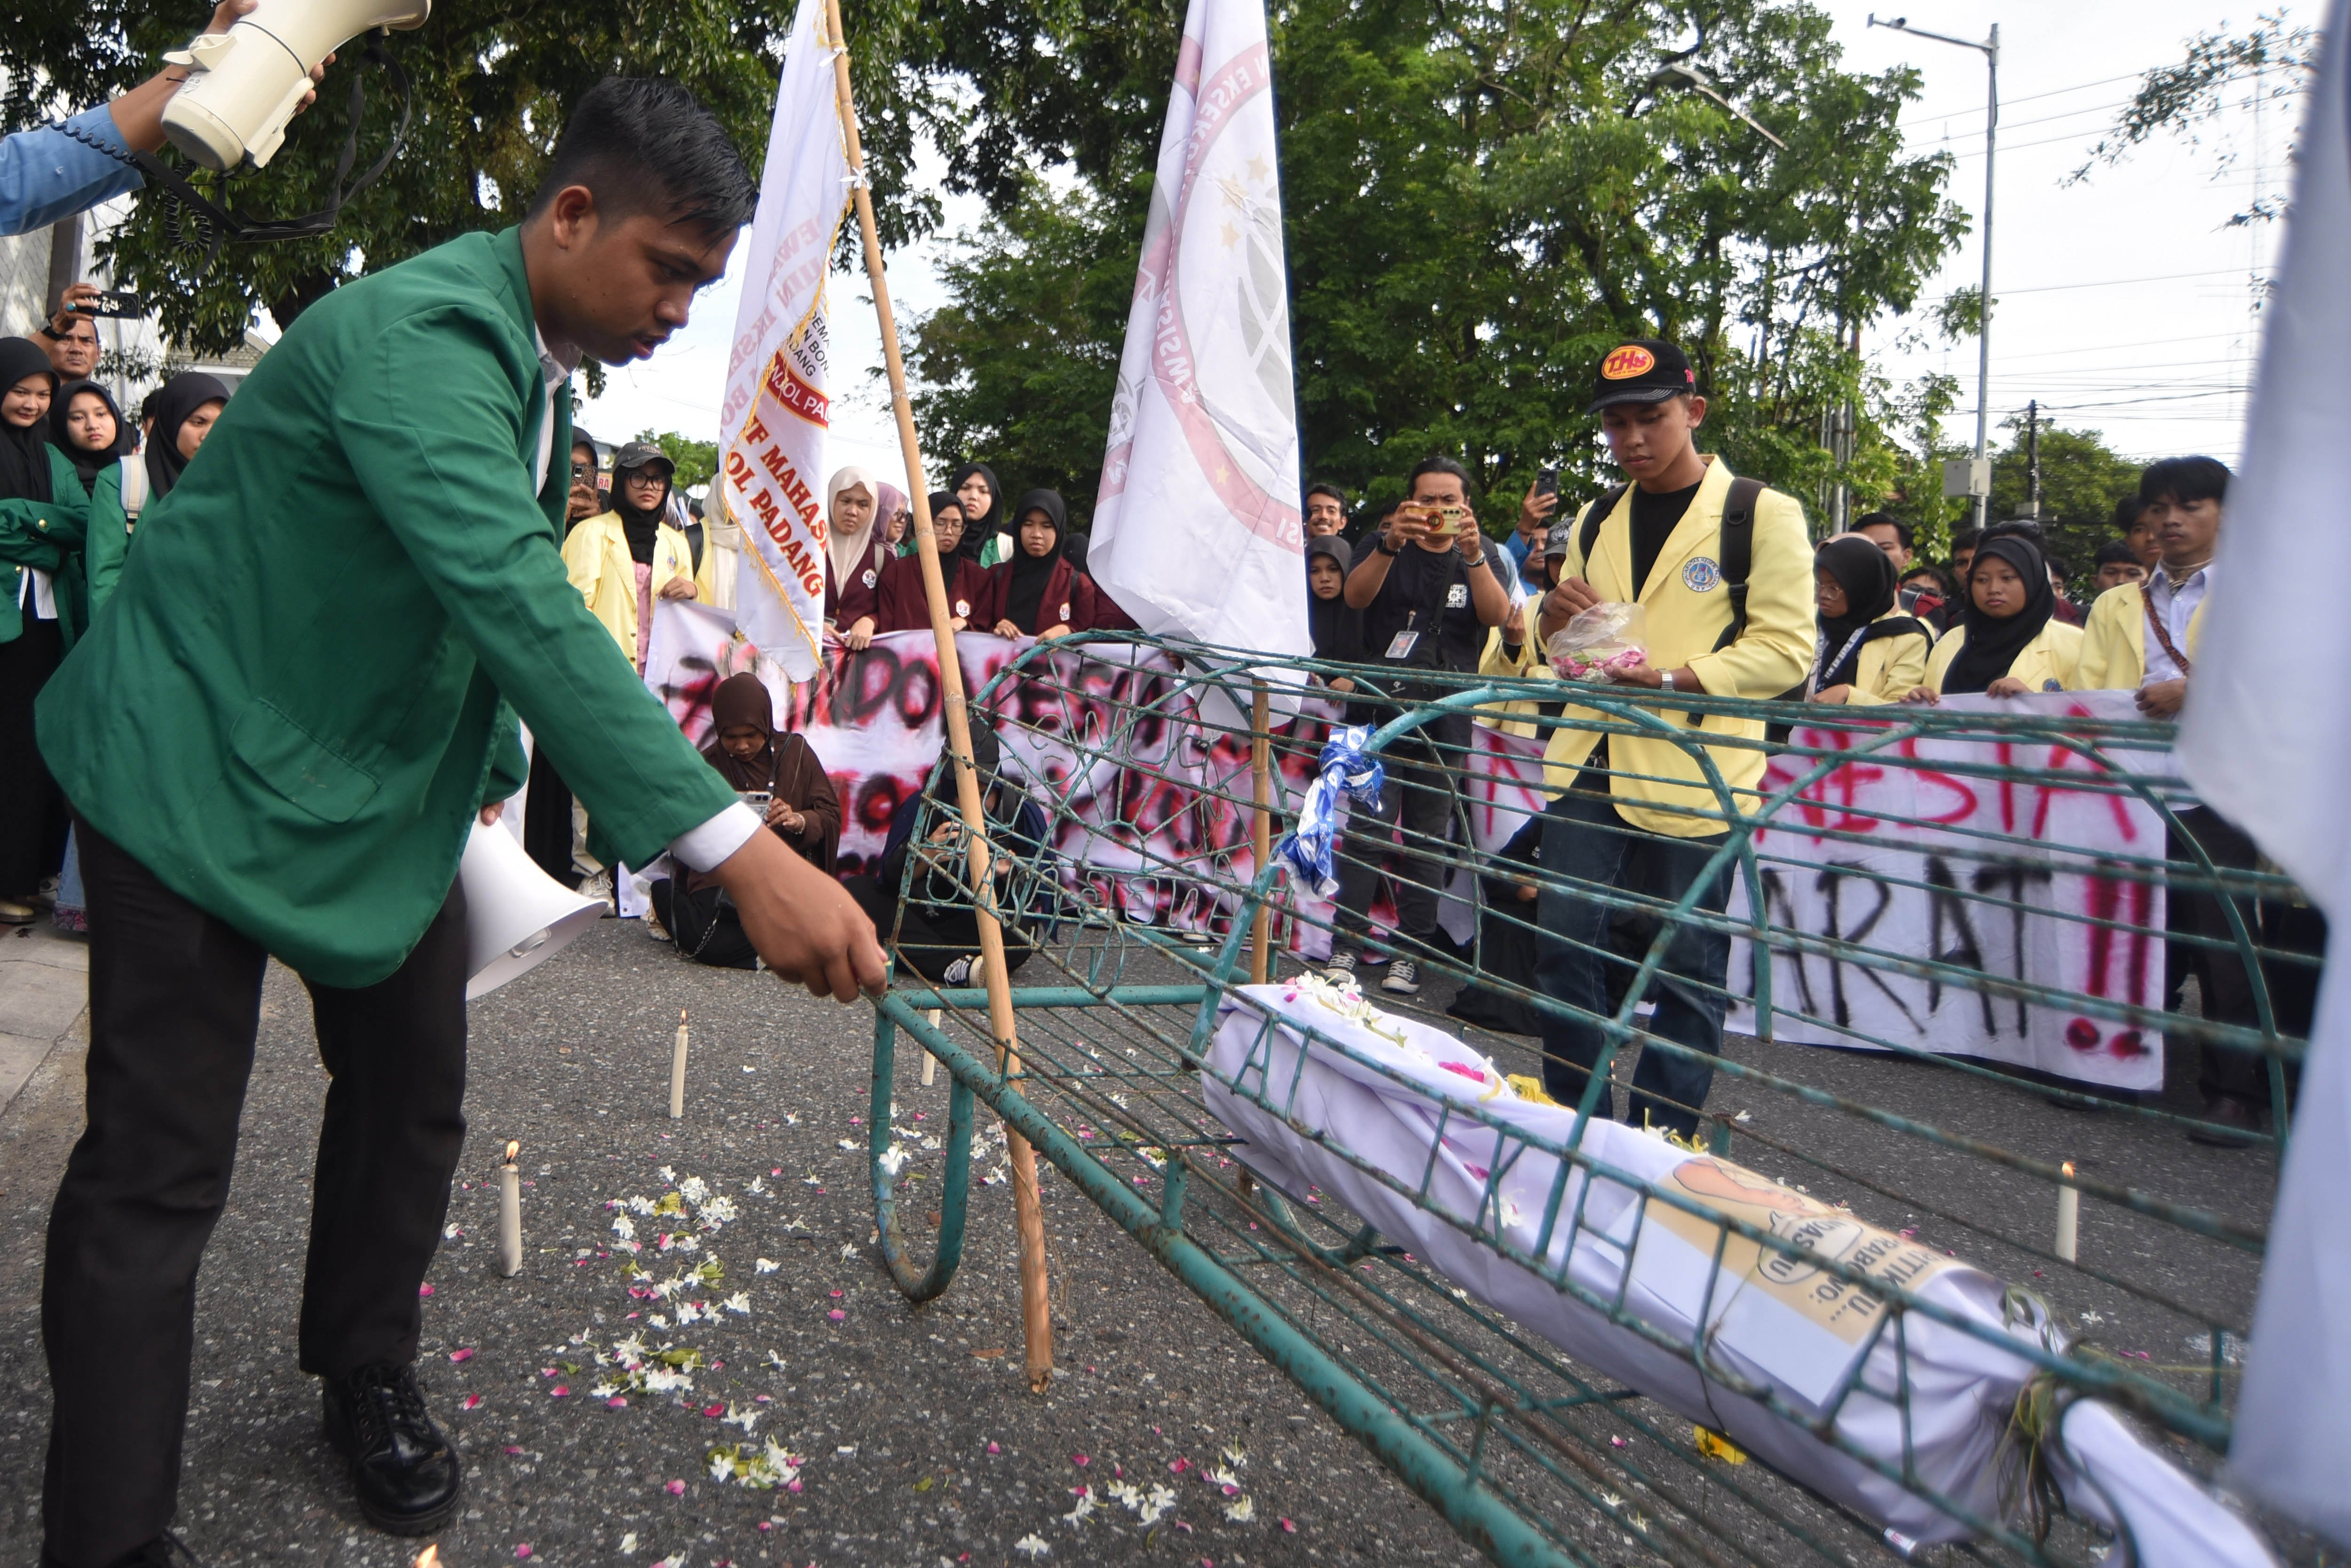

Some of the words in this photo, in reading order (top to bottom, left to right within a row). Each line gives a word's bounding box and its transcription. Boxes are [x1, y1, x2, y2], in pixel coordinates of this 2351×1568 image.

[808, 340, 829, 378] BON
[1608, 350, 1647, 374] THS
[771, 364, 801, 407] NJOL
[599, 478, 610, 489] RA
[728, 451, 756, 494] OL
[749, 488, 824, 599] PADANG
